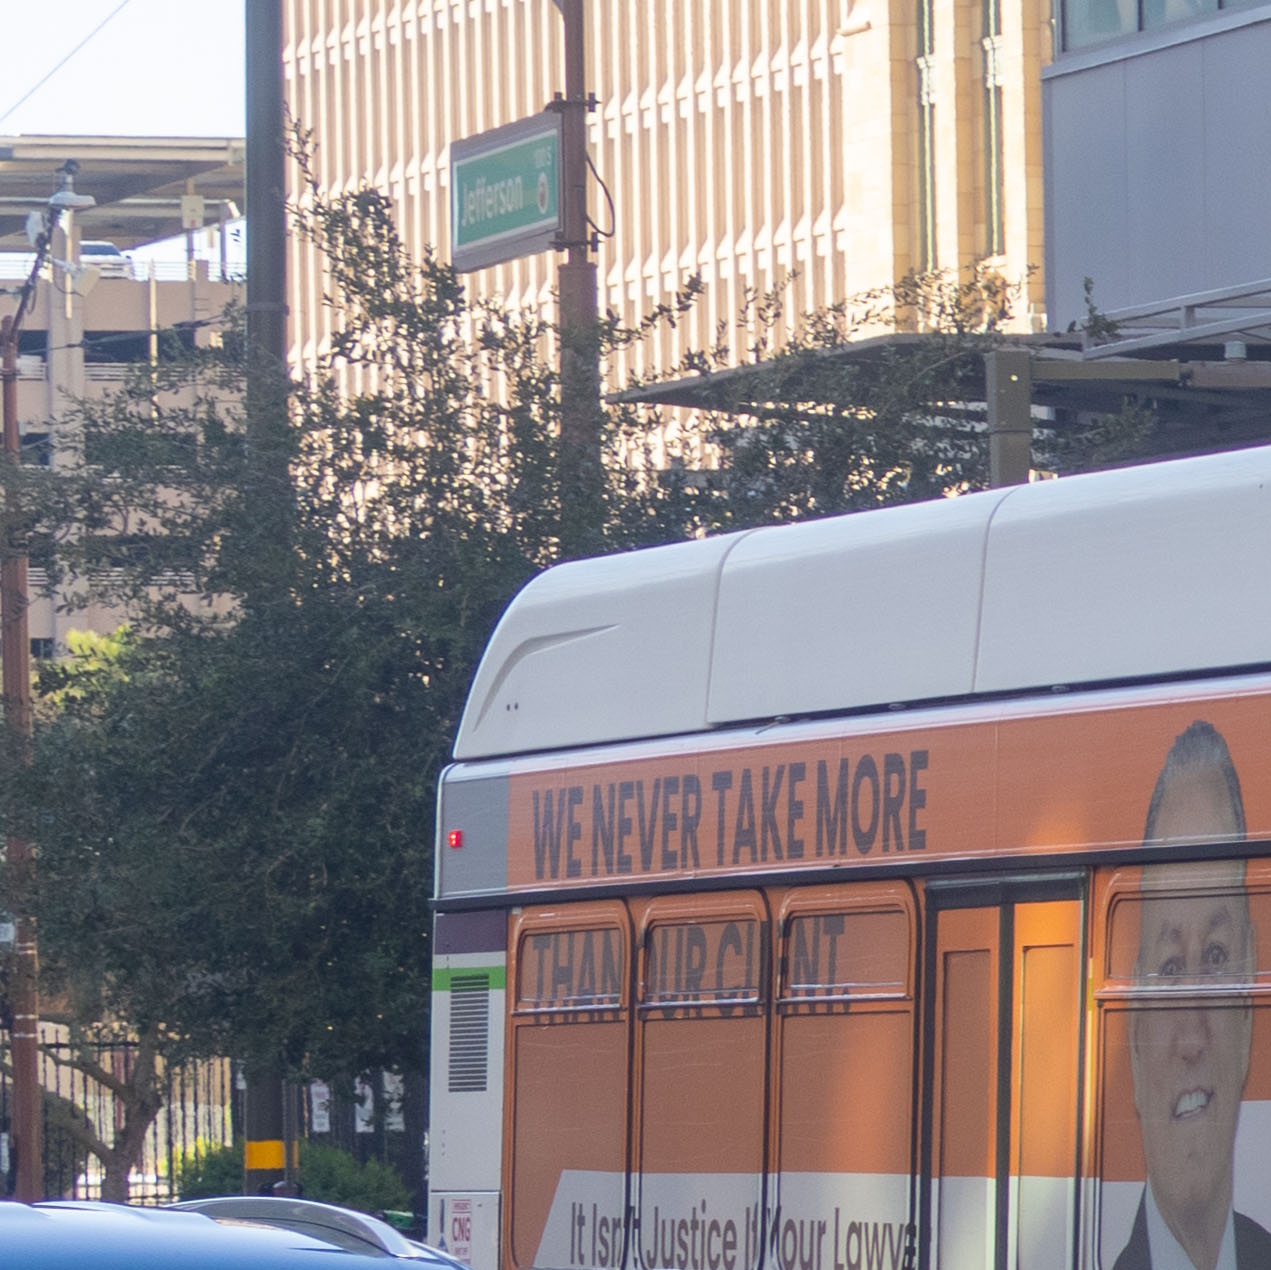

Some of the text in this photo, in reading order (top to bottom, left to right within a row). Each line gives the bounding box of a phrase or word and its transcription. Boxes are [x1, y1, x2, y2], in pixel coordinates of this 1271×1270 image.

[461, 176, 524, 227] Jefferson
[532, 750, 929, 880] WE NEVER TAKE MORE
[533, 928, 623, 1024] THAN
[452, 1217, 471, 1242] CNG
[570, 1202, 586, 1265] It
